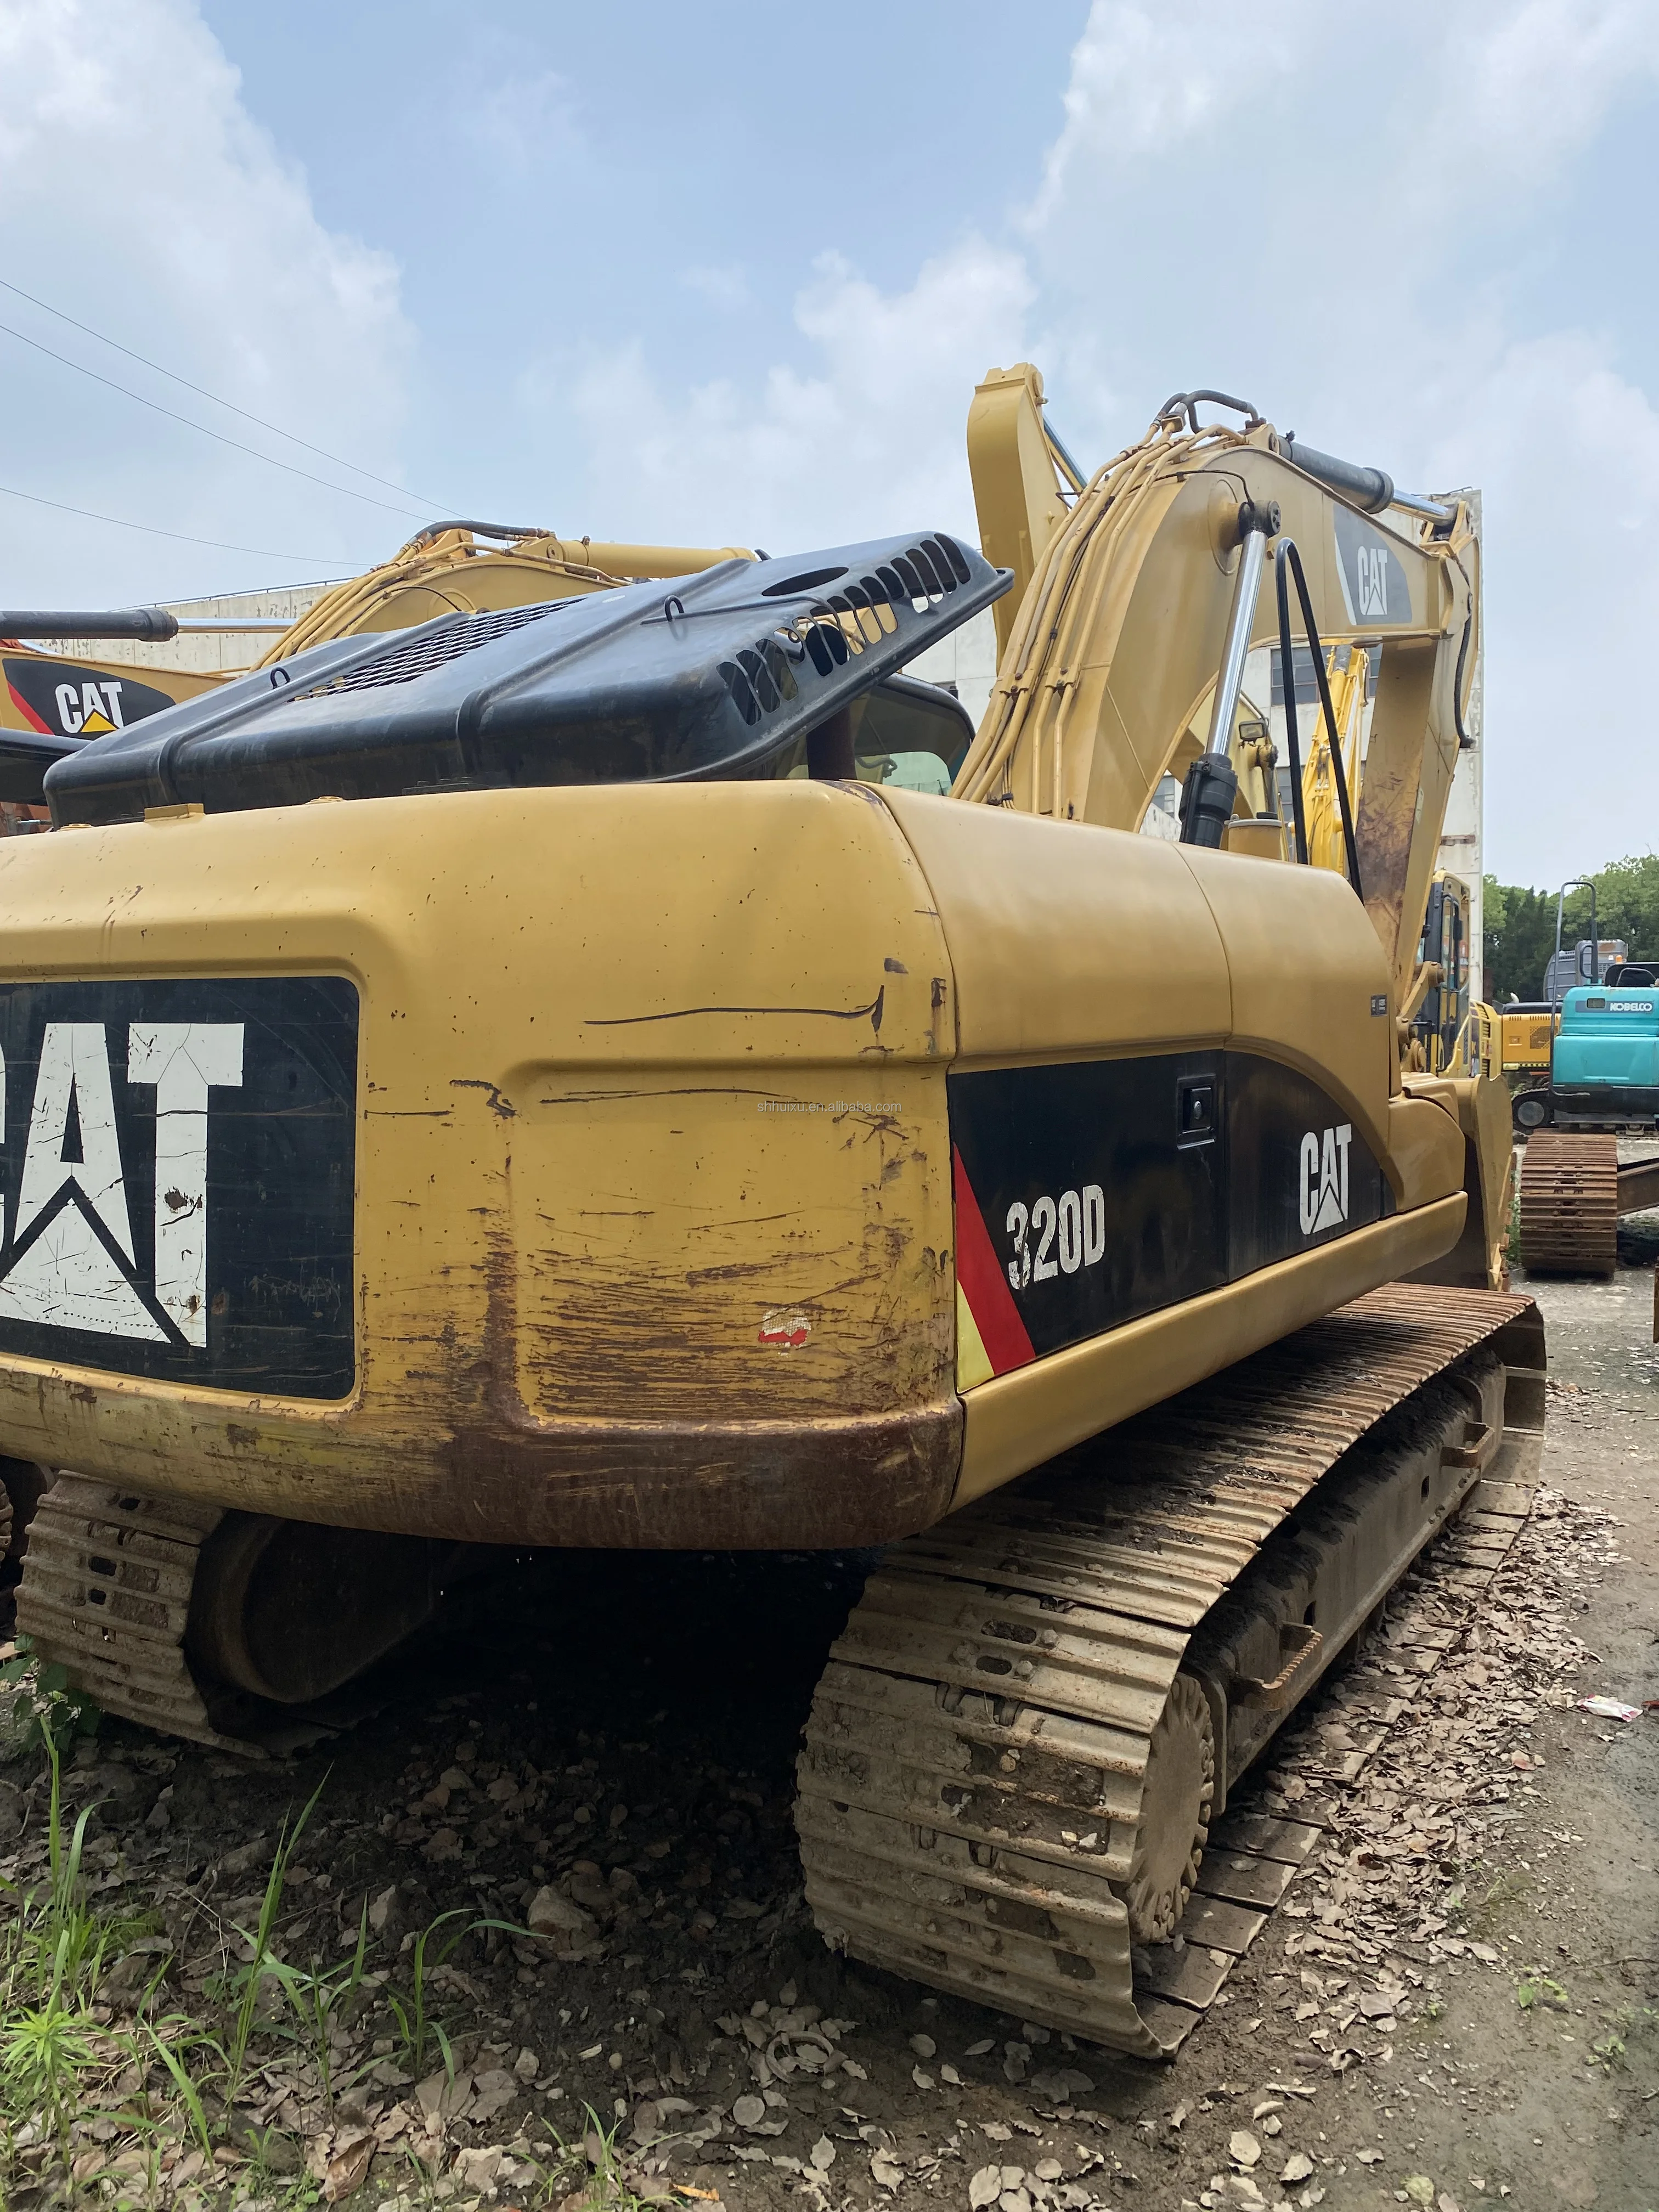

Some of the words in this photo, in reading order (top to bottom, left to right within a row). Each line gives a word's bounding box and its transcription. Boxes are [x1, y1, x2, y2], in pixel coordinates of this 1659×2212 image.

[1357, 546, 1387, 616] CAT
[55, 681, 124, 733] CAT
[1610, 1002, 1653, 1012] KOBELCO
[0, 1023, 245, 1348] AT
[1300, 1123, 1352, 1235] CAT
[1006, 1184, 1105, 1289] 320D
